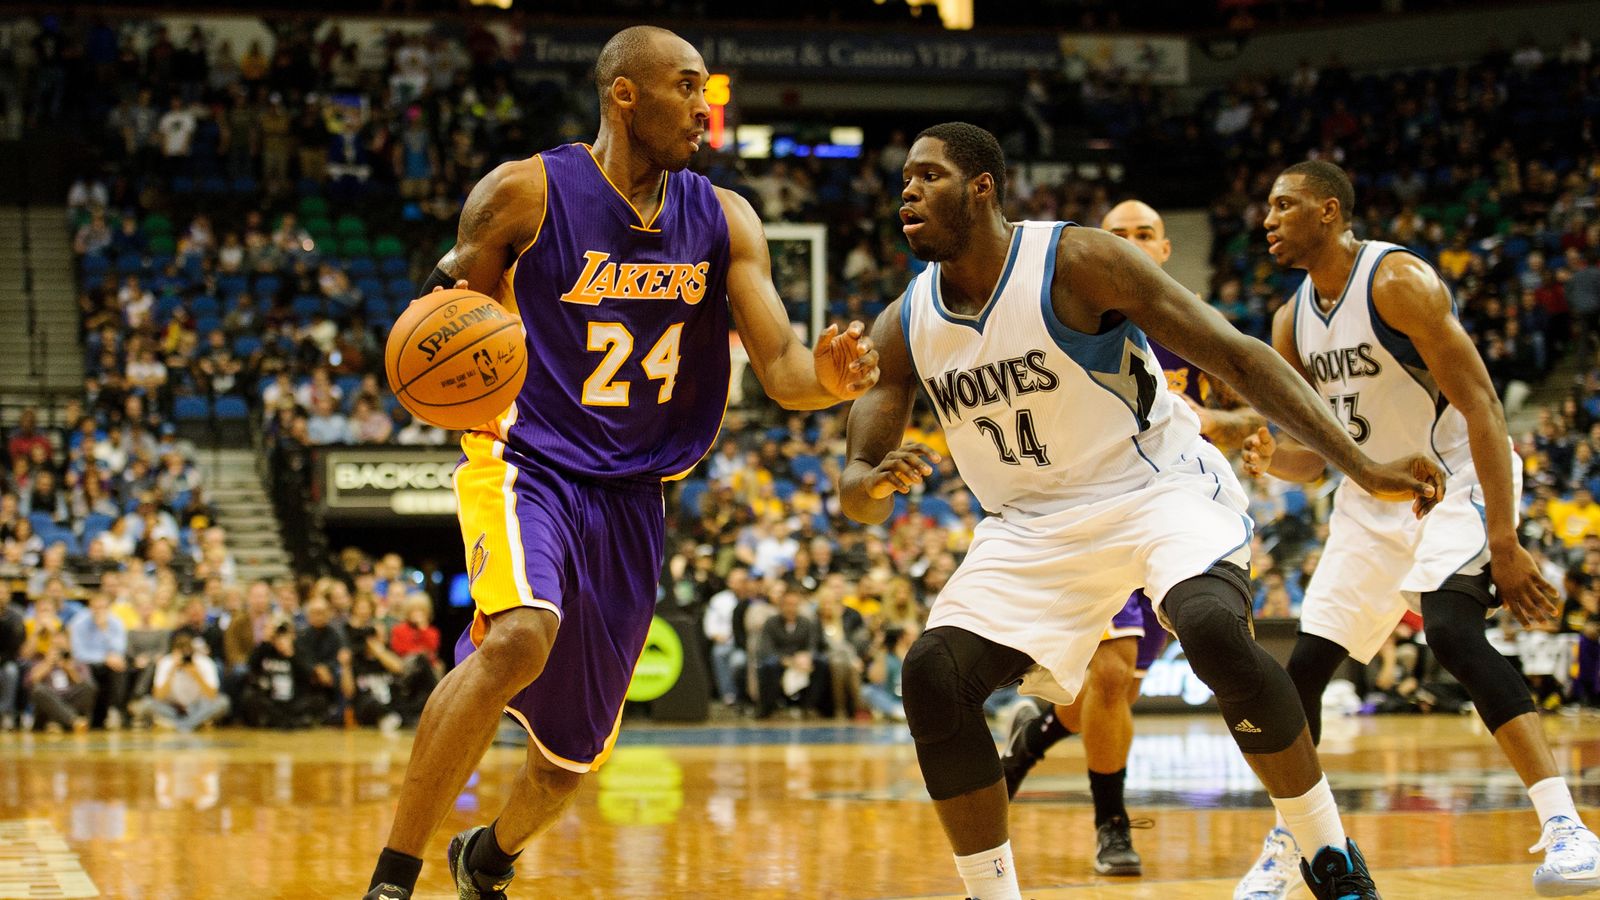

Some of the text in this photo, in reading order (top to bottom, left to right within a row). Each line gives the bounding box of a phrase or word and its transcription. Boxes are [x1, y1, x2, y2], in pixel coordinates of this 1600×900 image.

[560, 250, 710, 305] LAKERS
[417, 303, 506, 362] SPALDING
[581, 321, 685, 406] 24
[924, 349, 1060, 423] WOLVES
[973, 409, 1051, 467] 24
